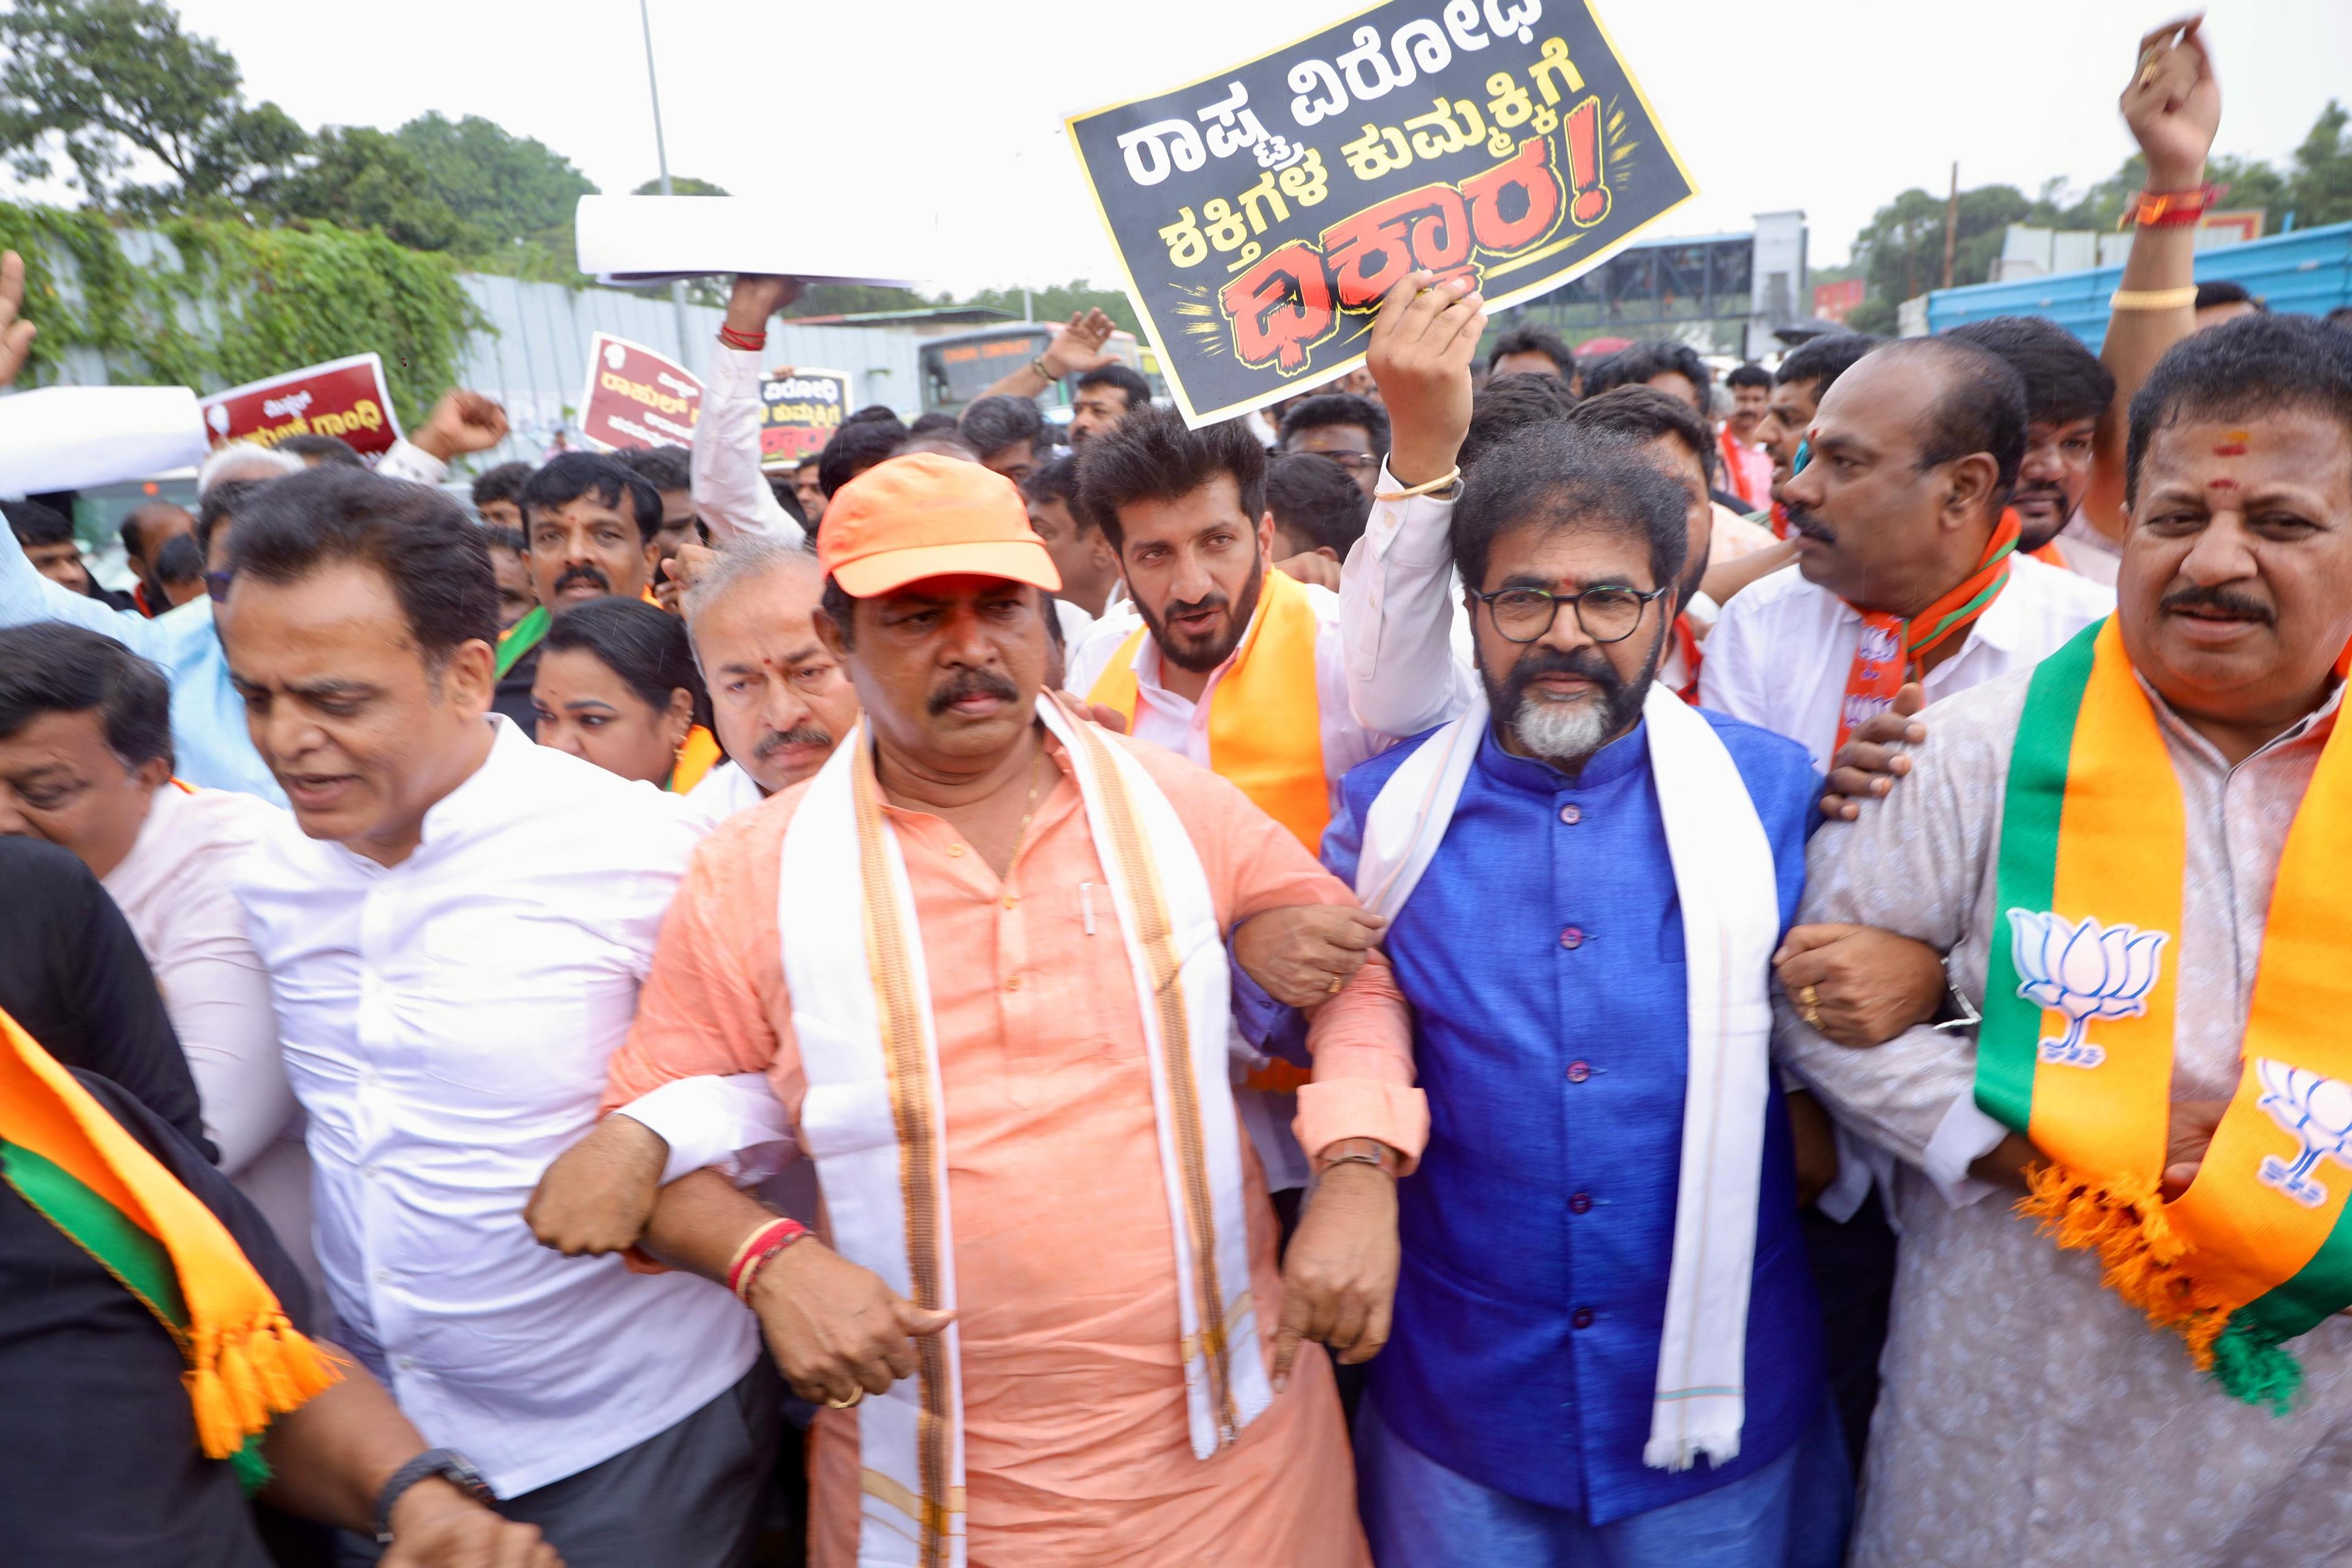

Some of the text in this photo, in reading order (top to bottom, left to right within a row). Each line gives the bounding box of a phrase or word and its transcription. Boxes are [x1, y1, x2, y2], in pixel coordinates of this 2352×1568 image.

[1116, 0, 1543, 186] ರಾಷ್ಟ್ರ ವಿರೋಧ
[1158, 36, 1585, 273] ಶಕ್ತಿಗಳ ಕುಮ್ಮಕ್ಕಿಗೆ
